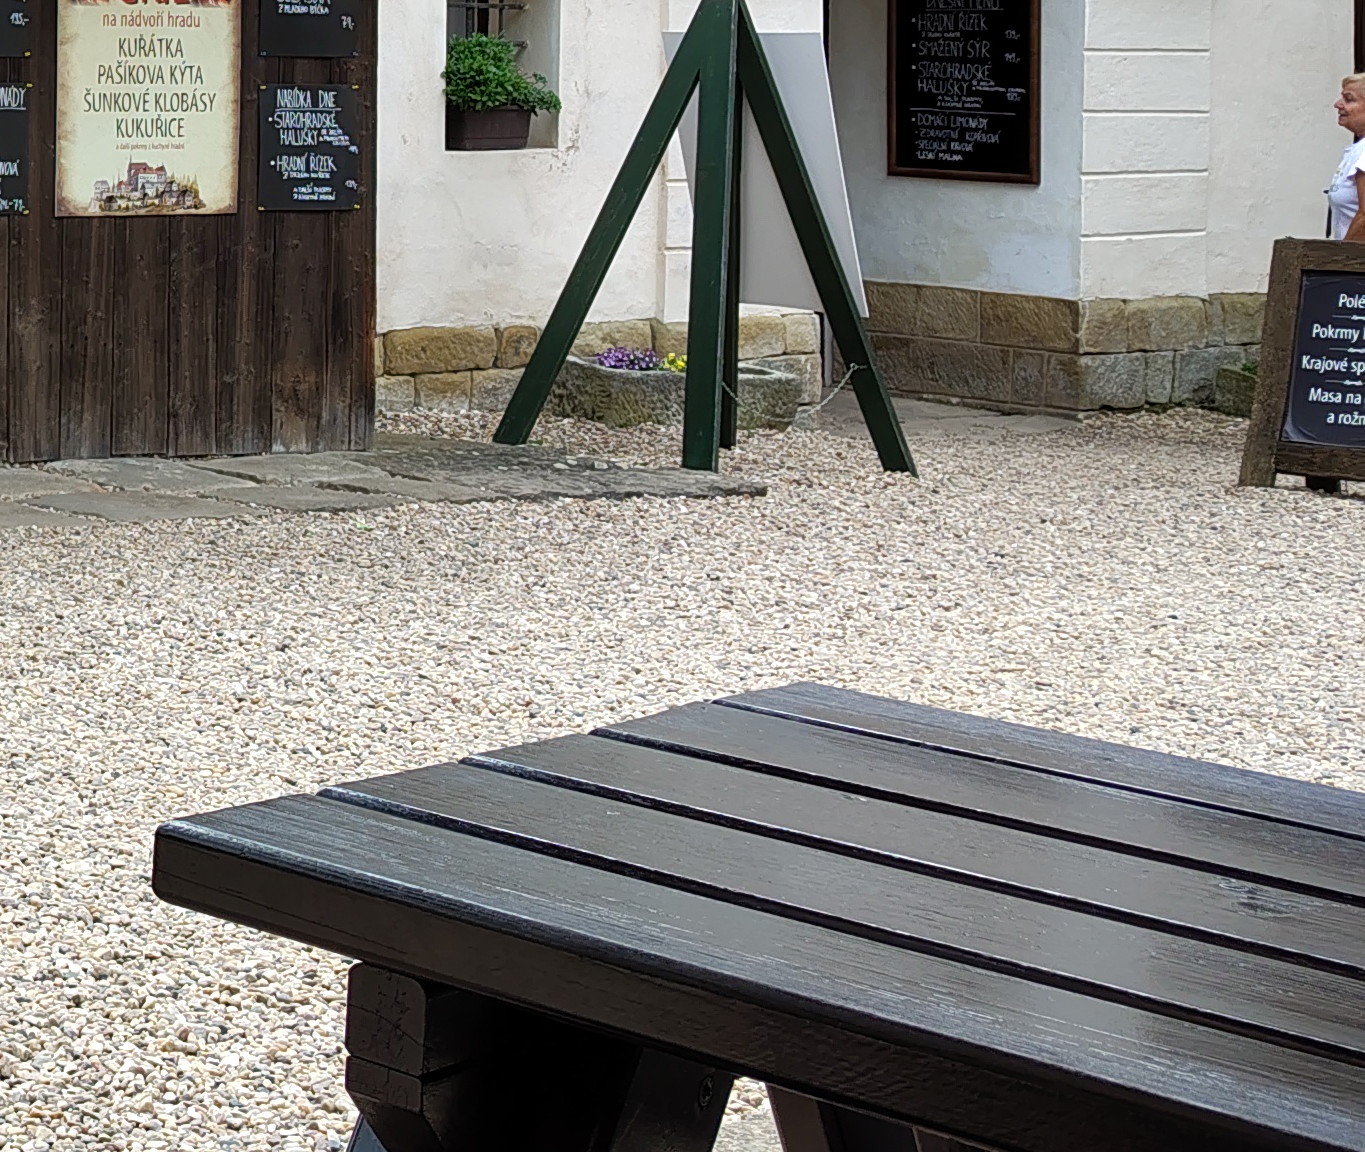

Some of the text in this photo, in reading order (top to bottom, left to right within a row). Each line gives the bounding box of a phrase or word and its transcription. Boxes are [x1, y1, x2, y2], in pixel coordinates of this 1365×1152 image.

[102, 10, 201, 28] na nádvoří hradu
[917, 11, 988, 31] HRADNÍ ŘÍZEK
[118, 33, 184, 58] KUŘÁTKA
[918, 37, 990, 58] SMAŽENÝ SÝR
[97, 60, 204, 85] PAŠÍKOVA KÝTA
[918, 61, 992, 80] STAROHRADSKÉ
[276, 86, 337, 108] NABÍDKA DNE
[917, 79, 969, 95] HALUŠKY
[83, 88, 217, 113] ŠUNKOVÉ KLOBÁSY
[115, 114, 185, 138] KUKUŘICE
[274, 110, 339, 128] STAROHRADSKÉ
[917, 111, 989, 130] DOMÁCÍ LIMONÁDY
[276, 152, 337, 172] HRADNÍ ŘÍZEK
[1311, 323, 1360, 343] Pokrmy
[1301, 355, 1348, 374] Krajové
[1308, 387, 1362, 405] Masa na
[1326, 412, 1335, 424] a
